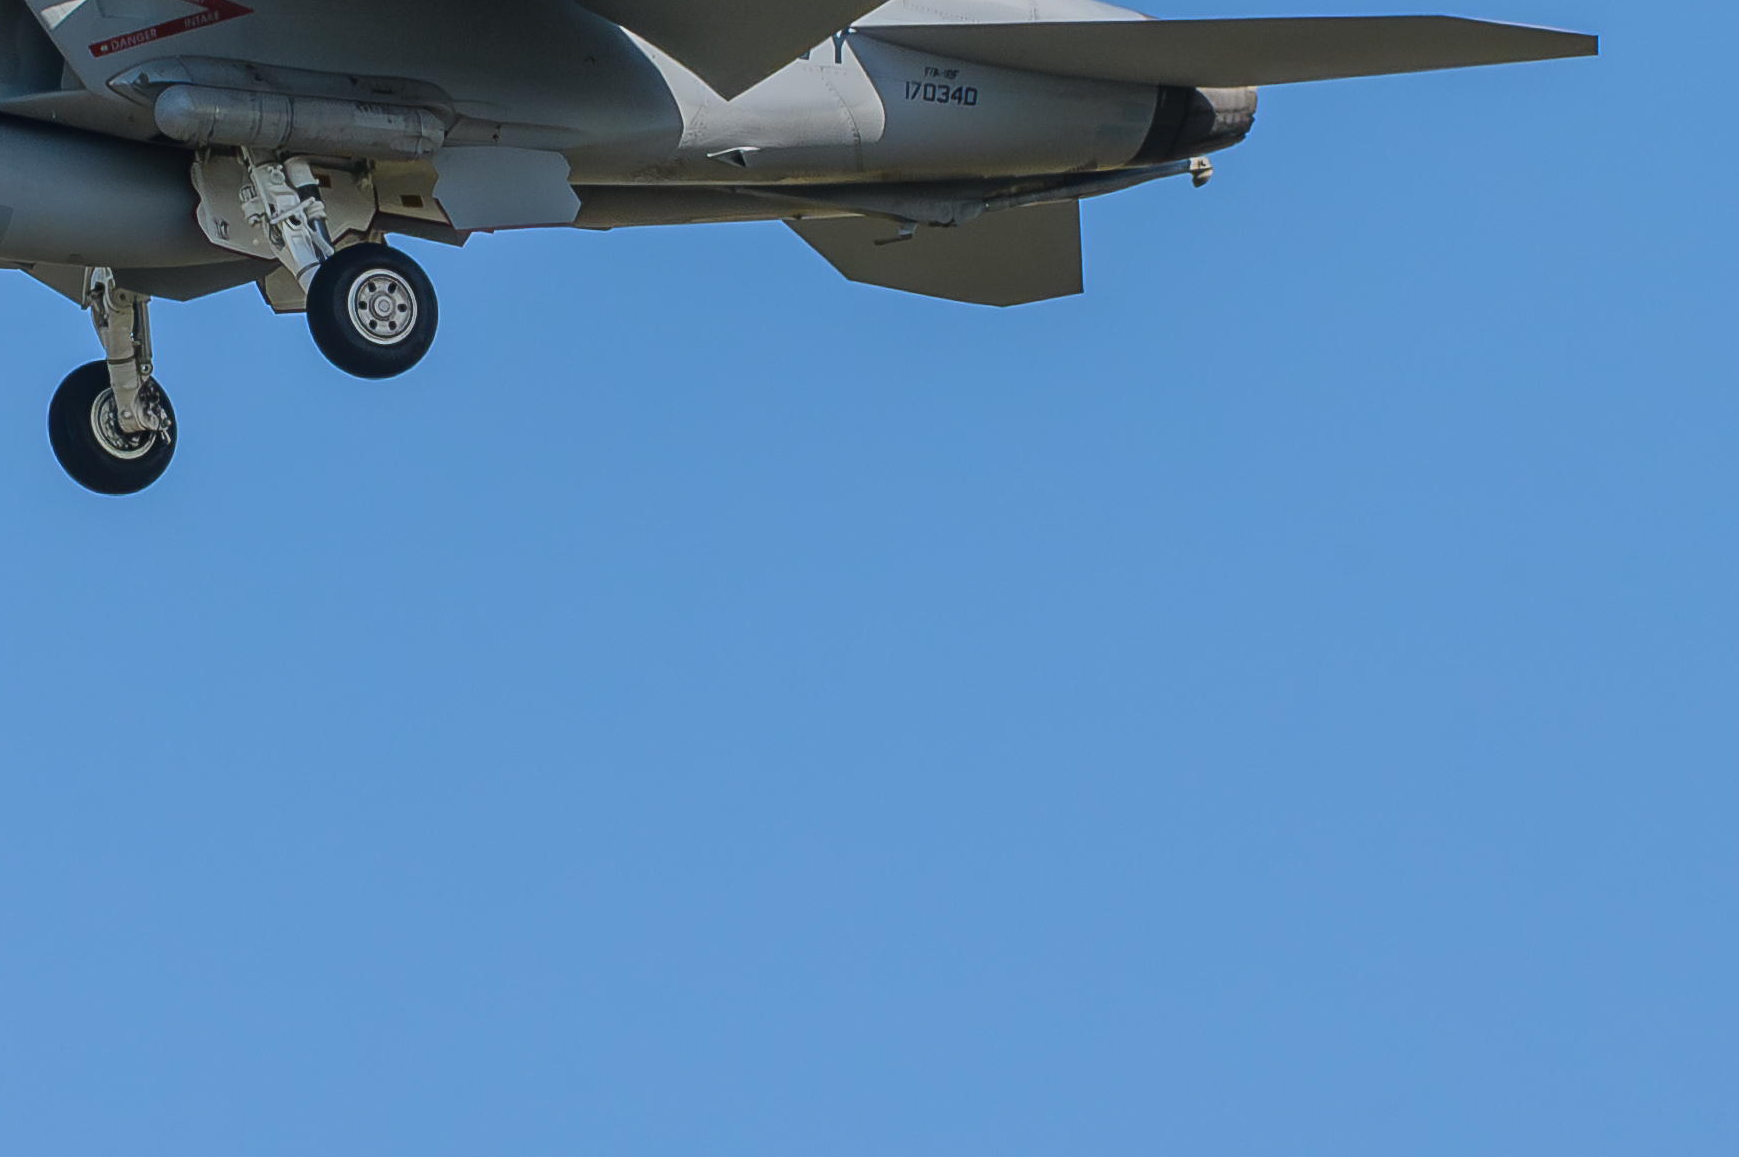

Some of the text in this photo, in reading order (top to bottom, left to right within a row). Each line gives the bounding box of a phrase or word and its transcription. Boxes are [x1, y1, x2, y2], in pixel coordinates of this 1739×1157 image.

[109, 9, 221, 50] DANGER INTAKE
[904, 79, 979, 107] 170340
